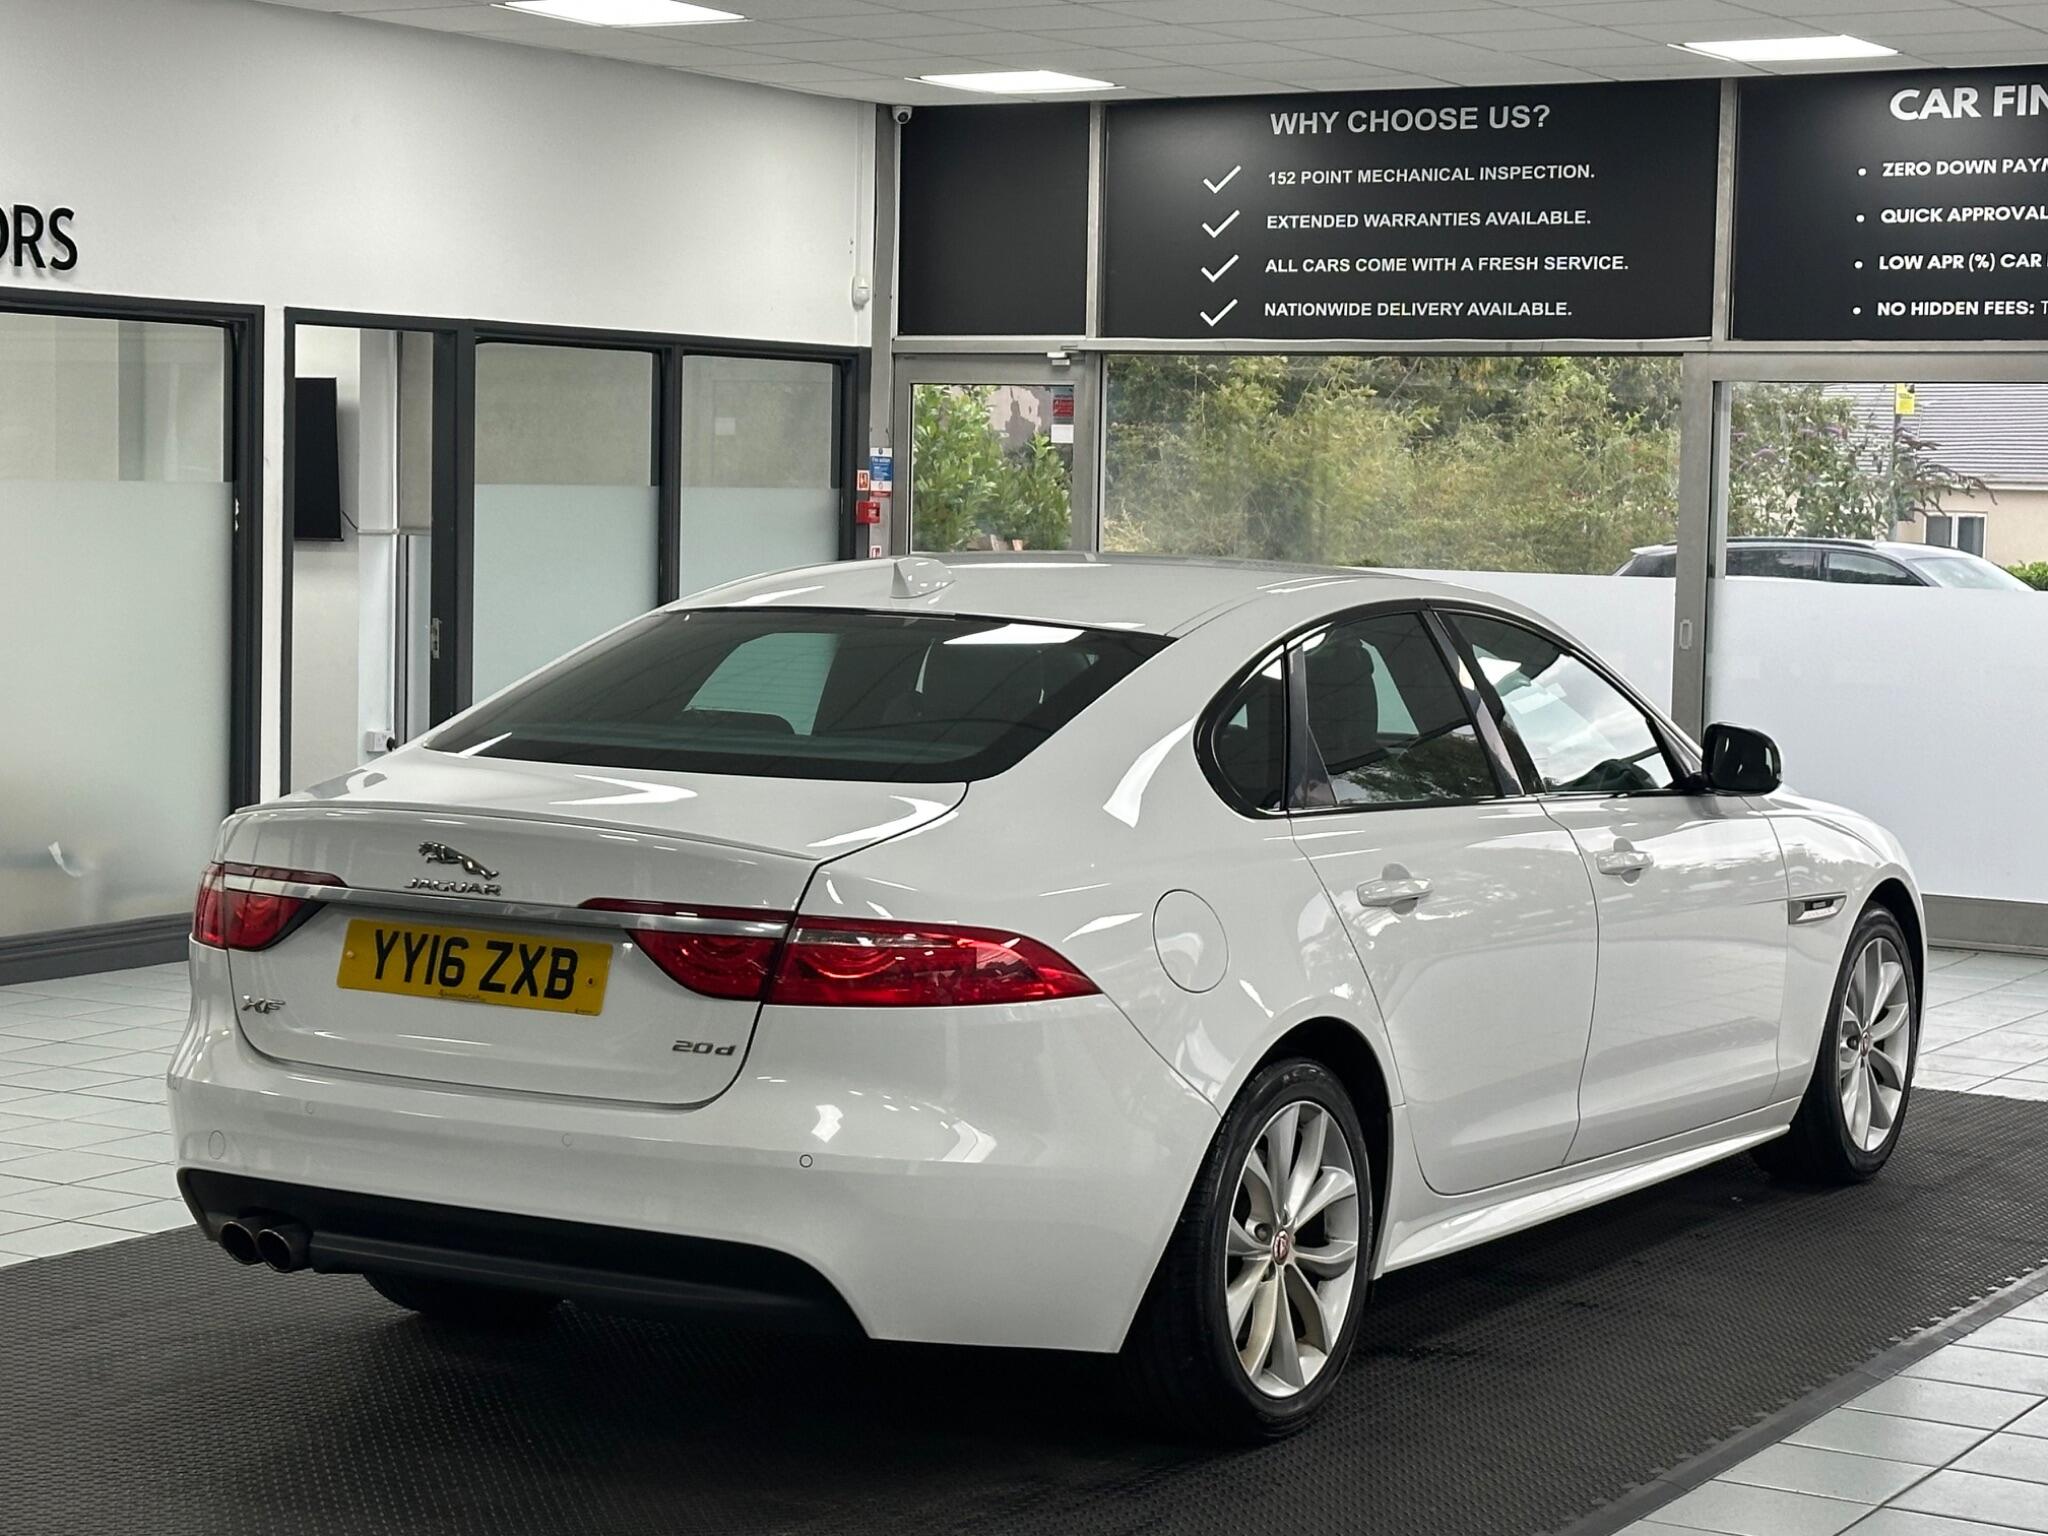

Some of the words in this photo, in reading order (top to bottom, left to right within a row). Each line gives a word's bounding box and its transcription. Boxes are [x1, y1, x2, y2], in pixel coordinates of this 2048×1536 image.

[1889, 87, 1982, 121] CAR
[1993, 84, 2048, 118] FIN
[1270, 111, 1340, 135] WHY
[1347, 106, 1479, 133] CHOOSE
[1489, 104, 1551, 129] US?
[1268, 171, 1296, 186] 152
[1300, 169, 1354, 185] POINT
[1357, 166, 1476, 184] MECHANICAL
[1479, 163, 1595, 181] INSPECTION.
[1882, 161, 1932, 178] ZERO
[1935, 159, 1997, 176] DOWN
[1266, 213, 1359, 230] EXTENDED
[1363, 211, 1481, 228] WARRANTIES
[1484, 209, 1592, 227] AVAILABLE.
[1880, 207, 1944, 224] QUICK
[1946, 205, 2048, 223] APPROVAL
[0, 203, 78, 271] RS
[1264, 258, 1299, 274] ALL
[1302, 258, 1351, 273] CARS
[1355, 257, 1408, 273] COME
[1411, 257, 1457, 272] WITH
[1460, 257, 1474, 272] A
[1478, 256, 1539, 272] FRESH
[1543, 255, 1629, 271] SERVICE.
[1878, 254, 1924, 271] LOW
[1926, 254, 1965, 270] APR
[1968, 252, 1996, 273] (%)
[1999, 253, 2043, 269] CAR
[1264, 302, 1373, 317] NATIONWIDE
[1376, 301, 1465, 317] DELIVERY
[1466, 301, 1573, 317] AVAILABLE.
[1876, 301, 1907, 317] NO
[1910, 300, 1979, 316] HIDDEN
[1983, 300, 2035, 316] FEES:
[404, 878, 502, 896] JAGUAR
[374, 928, 467, 988] YY16
[478, 939, 579, 1001] ZXB
[241, 994, 286, 1015] XF
[672, 1039, 737, 1057] 20d
